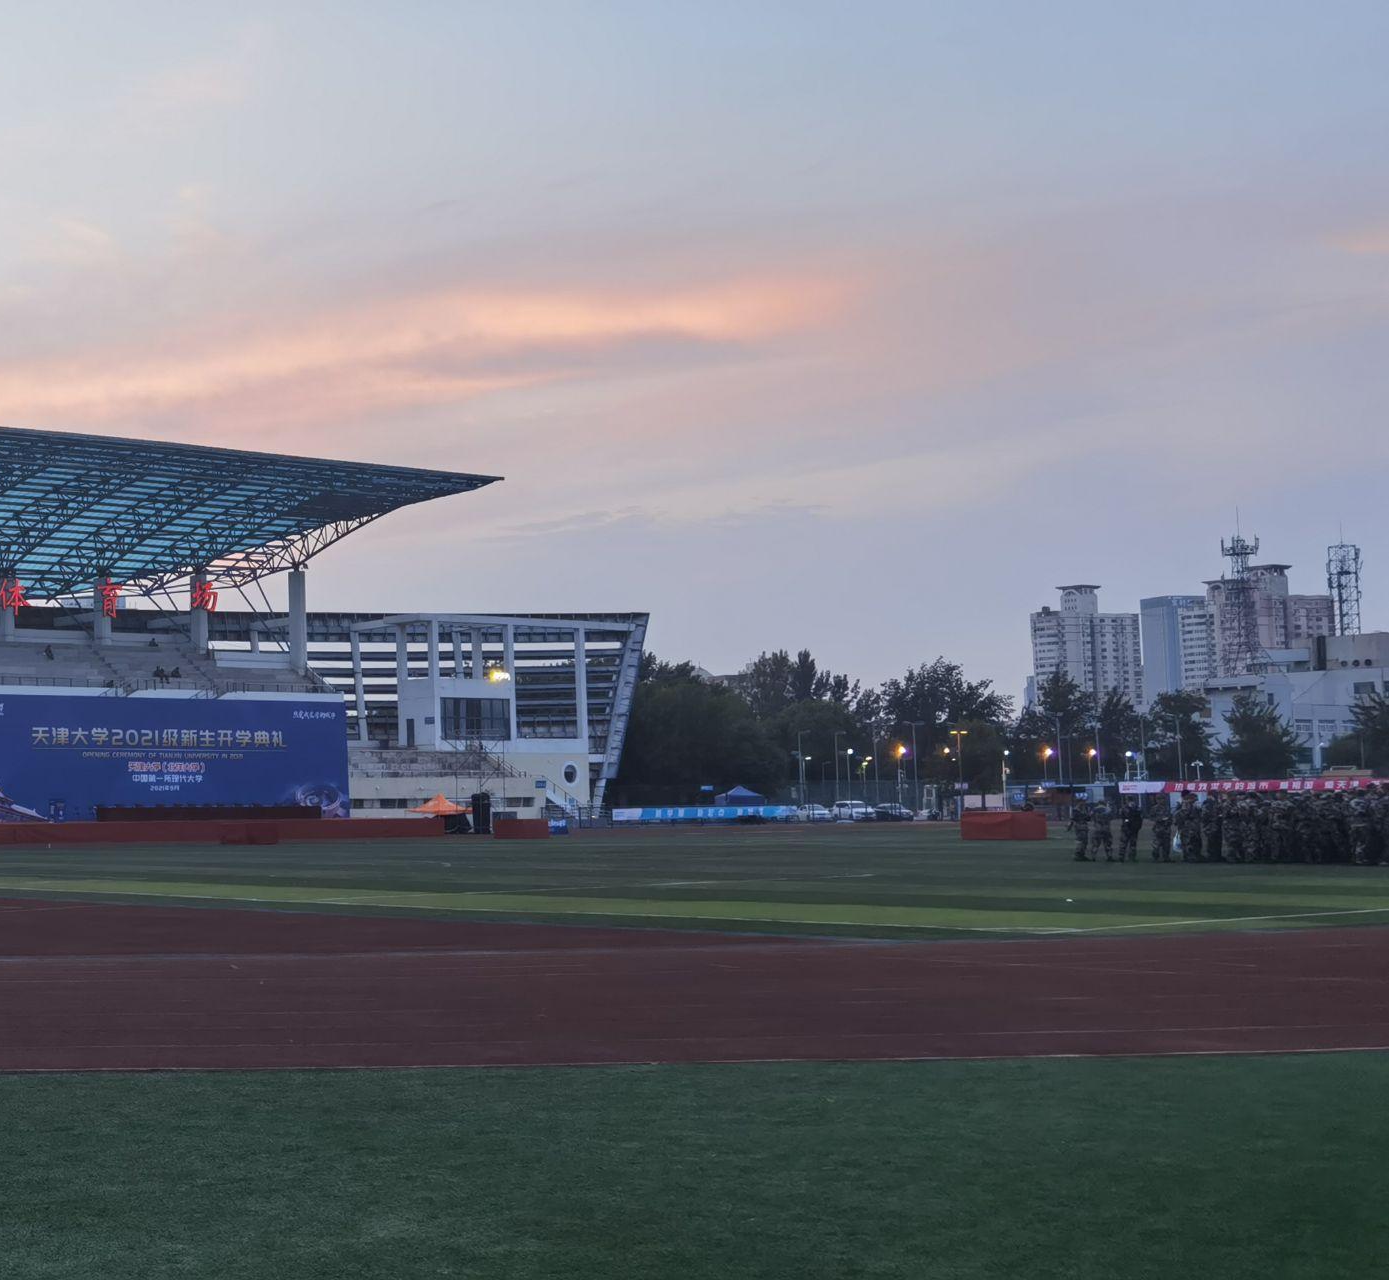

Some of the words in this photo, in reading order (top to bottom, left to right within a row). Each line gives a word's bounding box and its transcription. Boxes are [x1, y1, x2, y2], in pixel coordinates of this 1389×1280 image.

[31, 727, 287, 749] 天津大学2021级新生开学典礼
[82, 751, 111, 759] OPENING
